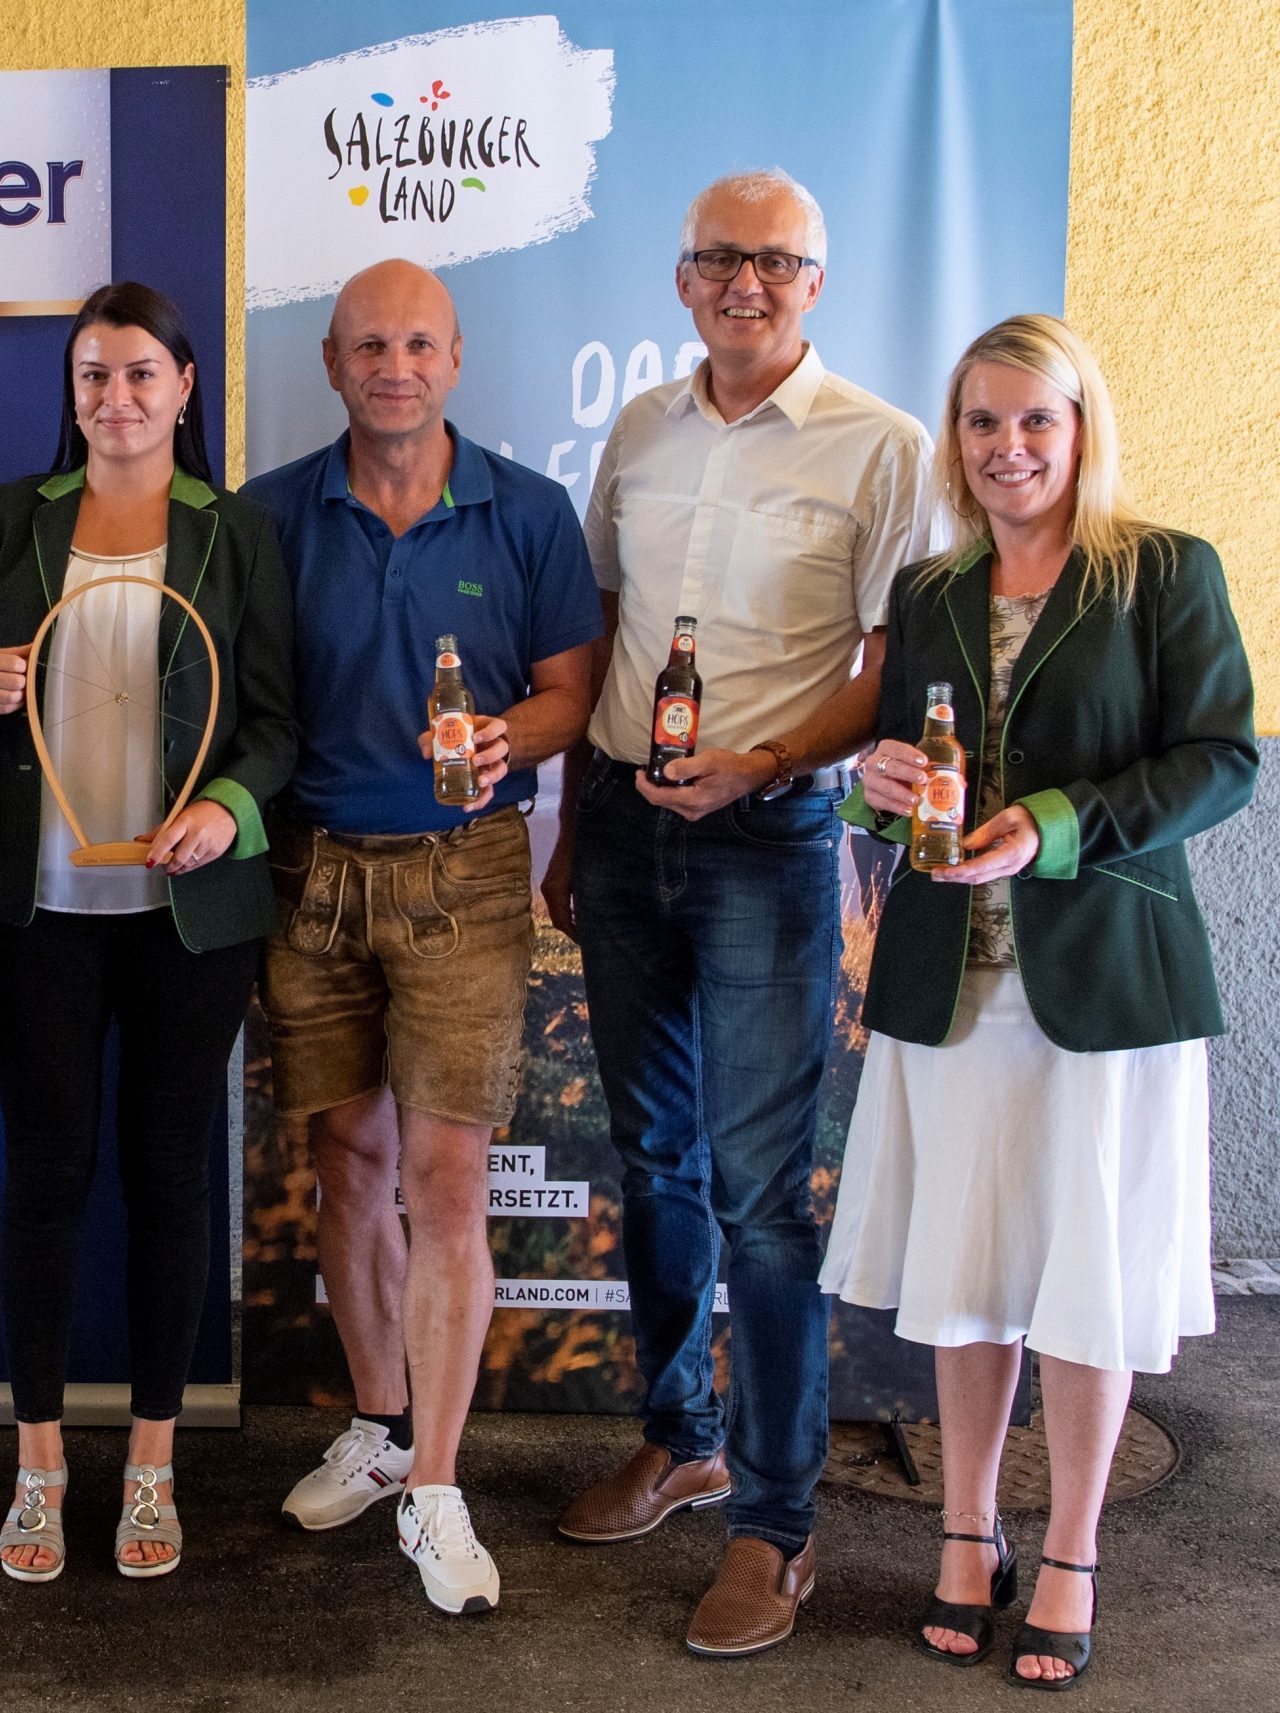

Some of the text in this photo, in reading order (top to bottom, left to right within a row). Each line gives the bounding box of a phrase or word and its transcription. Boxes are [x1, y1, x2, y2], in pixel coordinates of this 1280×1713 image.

[323, 107, 541, 180] SALZBURGER
[379, 167, 455, 223] LAND
[458, 580, 483, 592] BOSS
[666, 713, 689, 726] HOPS
[441, 729, 463, 742] HOPS
[487, 1154, 535, 1176] ENT,
[489, 1189, 579, 1208] RSETZT.
[494, 1286, 589, 1303] RLAND.COM
